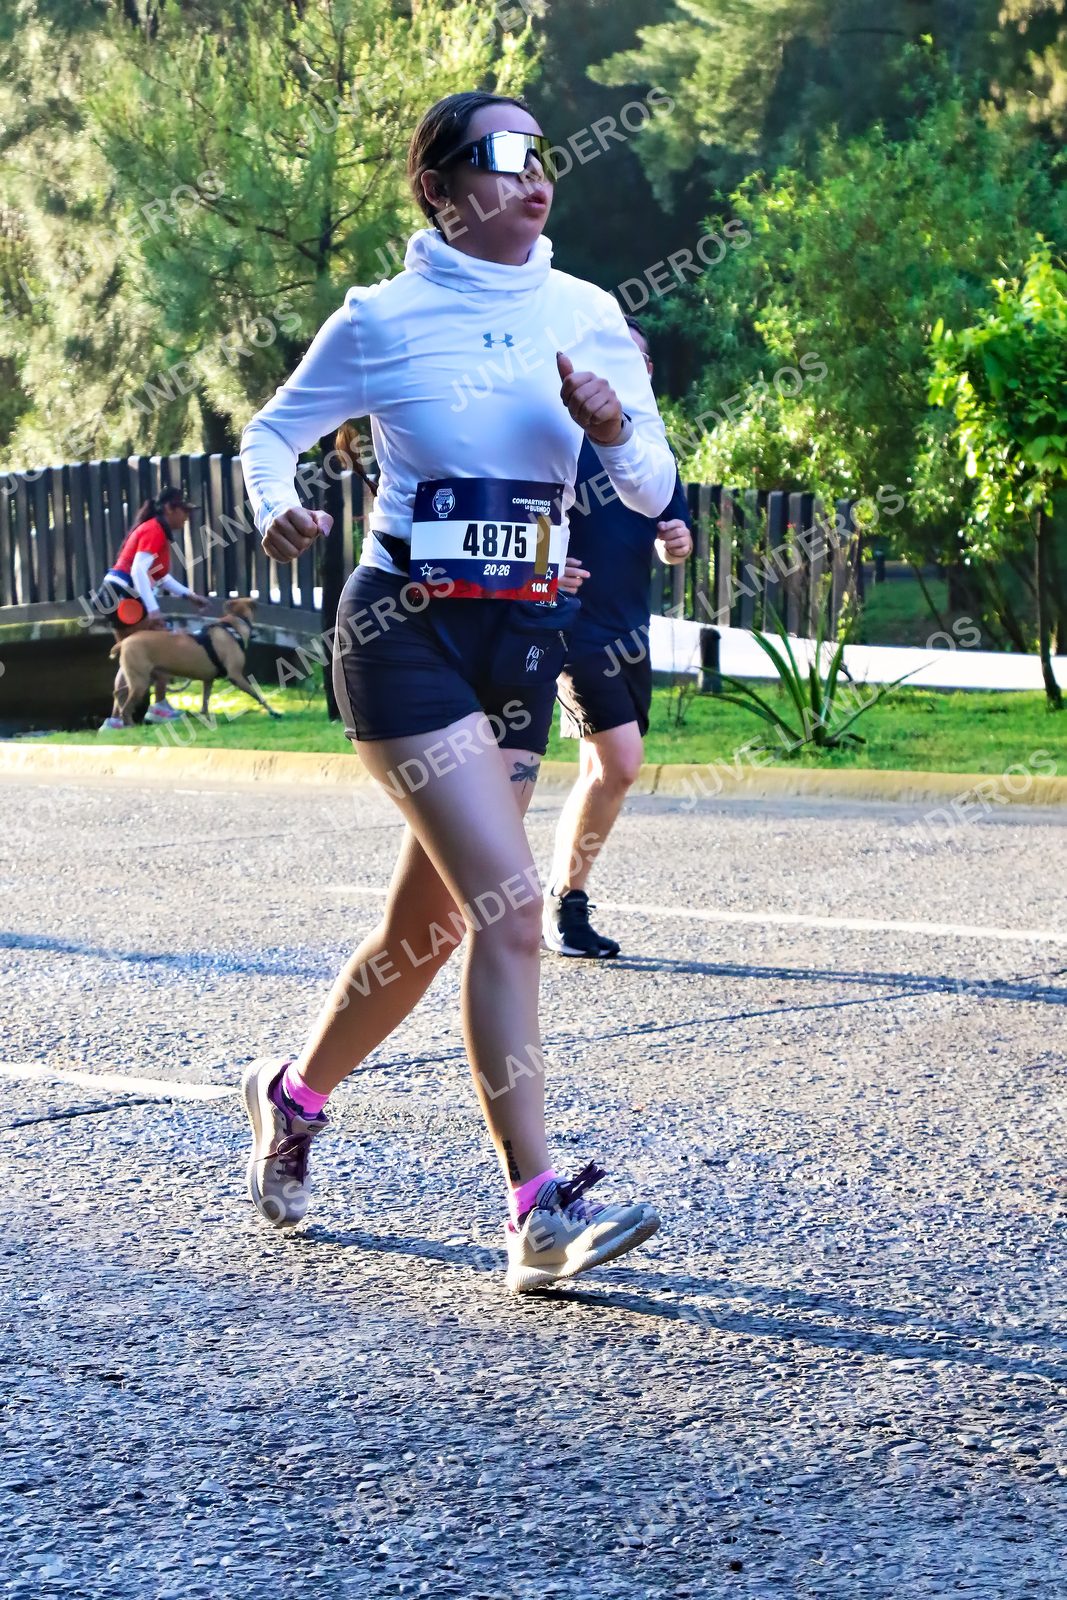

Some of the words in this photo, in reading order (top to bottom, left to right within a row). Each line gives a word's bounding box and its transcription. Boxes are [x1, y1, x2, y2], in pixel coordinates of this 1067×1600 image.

[512, 498, 551, 506] COMPARTIMOS
[463, 523, 527, 559] 4875
[531, 583, 549, 593] 10K
